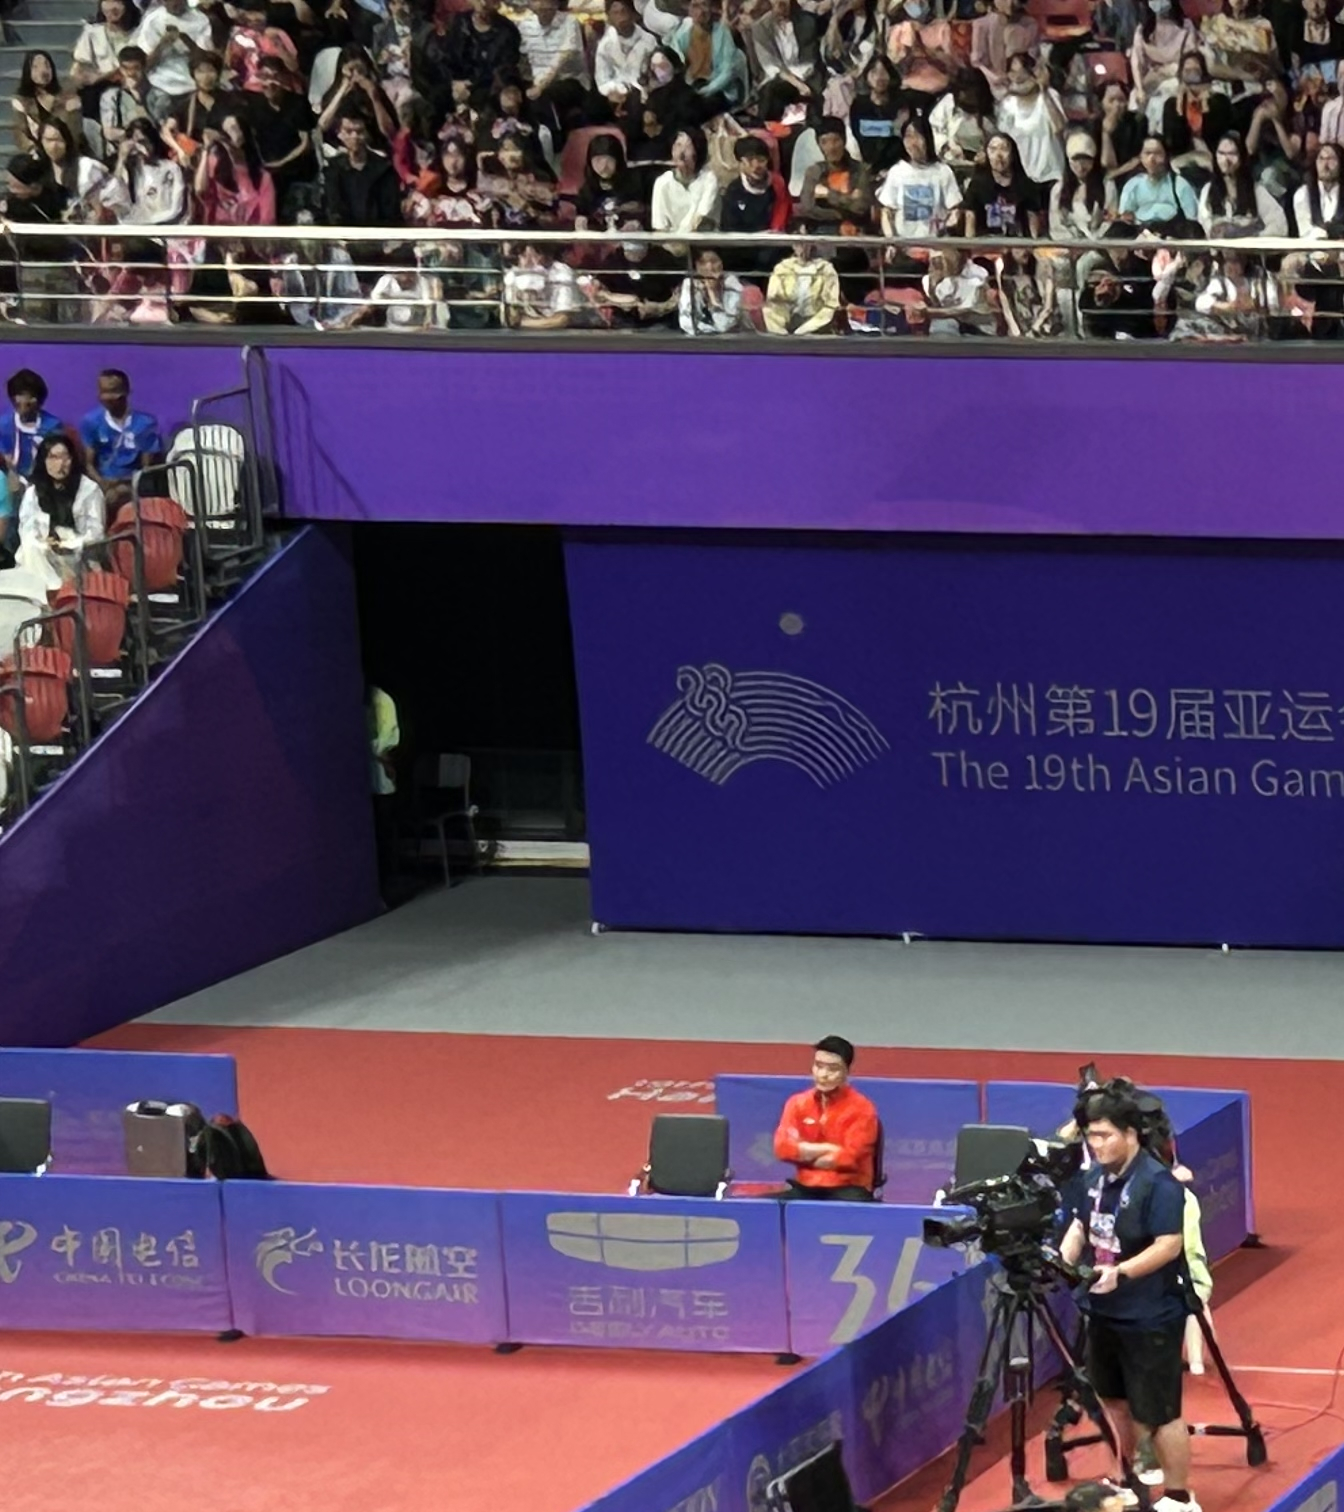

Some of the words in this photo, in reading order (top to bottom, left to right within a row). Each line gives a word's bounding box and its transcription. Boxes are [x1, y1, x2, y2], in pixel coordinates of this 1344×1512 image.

[930, 752, 1009, 791] The
[1025, 754, 1111, 793] 19th
[1124, 757, 1237, 797] Asian
[0, 1386, 310, 1412] ngzhou
